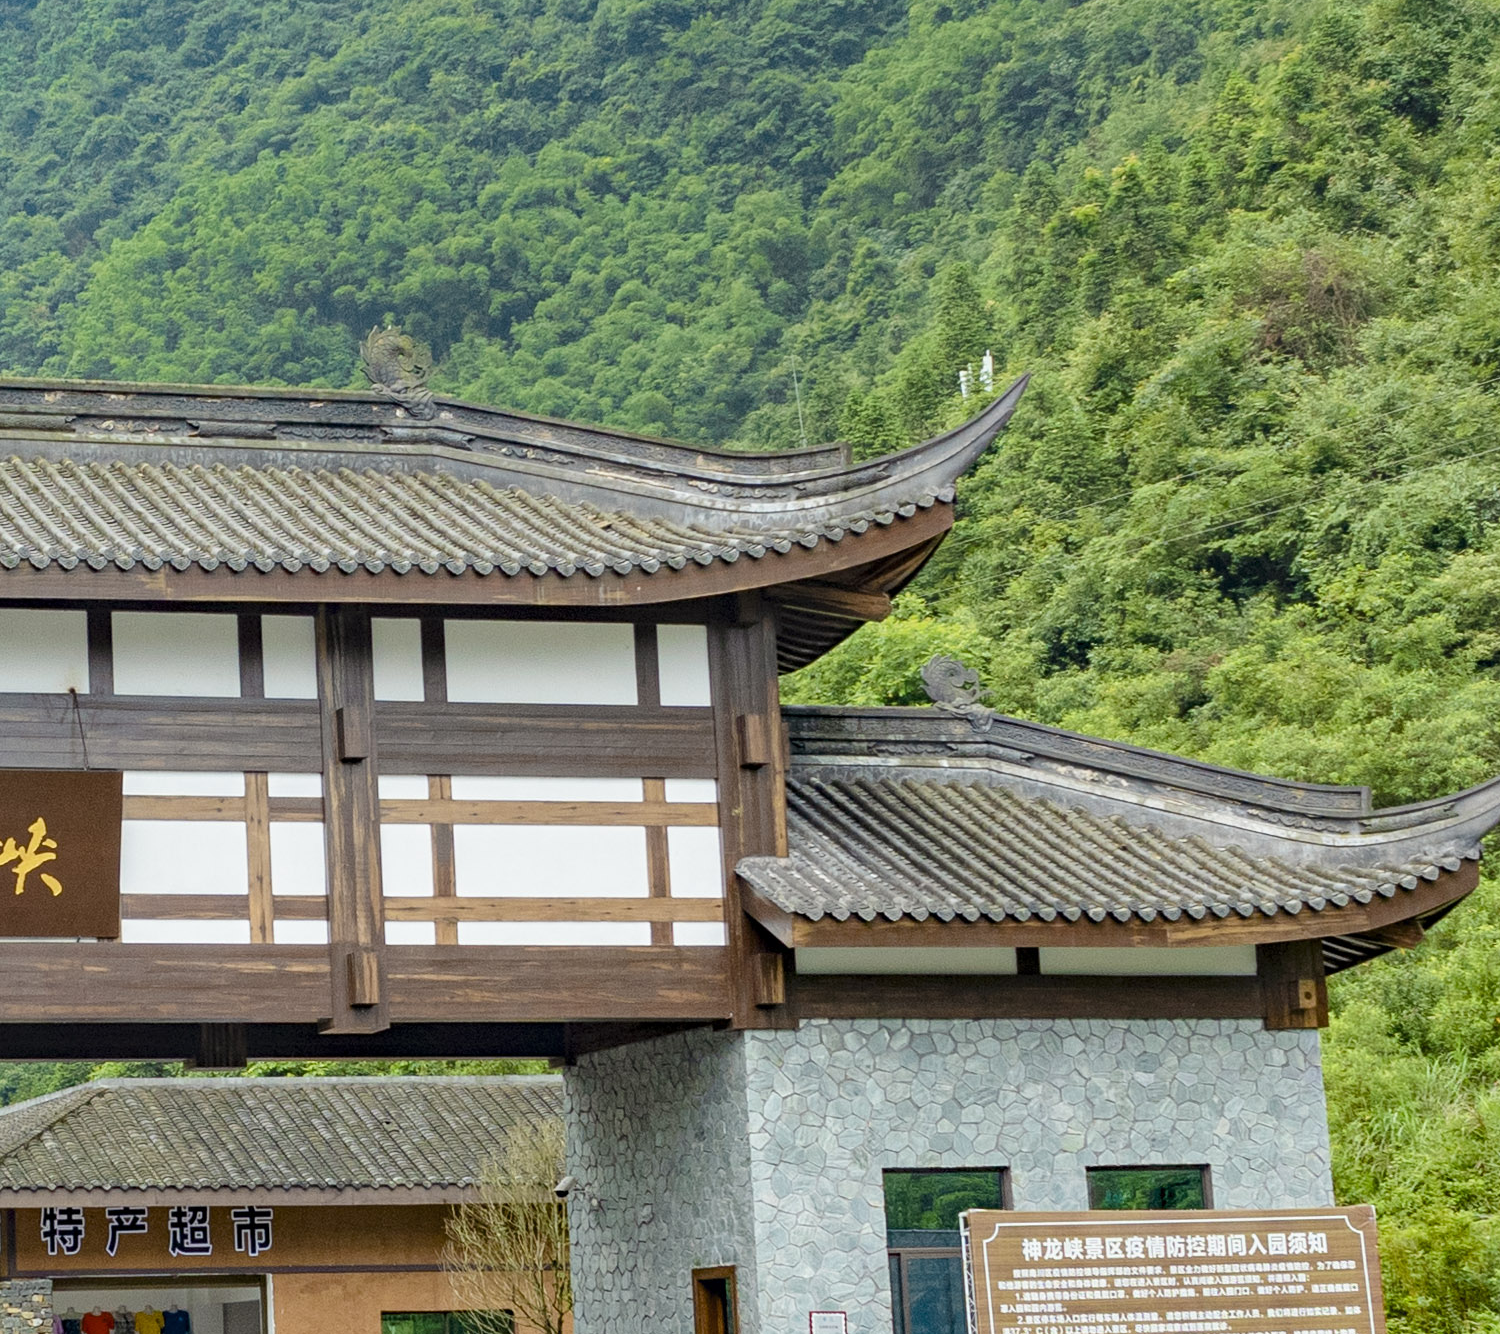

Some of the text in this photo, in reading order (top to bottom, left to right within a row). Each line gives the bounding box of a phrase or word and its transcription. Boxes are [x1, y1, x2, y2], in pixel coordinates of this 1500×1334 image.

[41, 1206, 273, 1257] 特产超市
[1022, 1232, 1328, 1261] 神龙峡景区疫情防控期间入园须知
